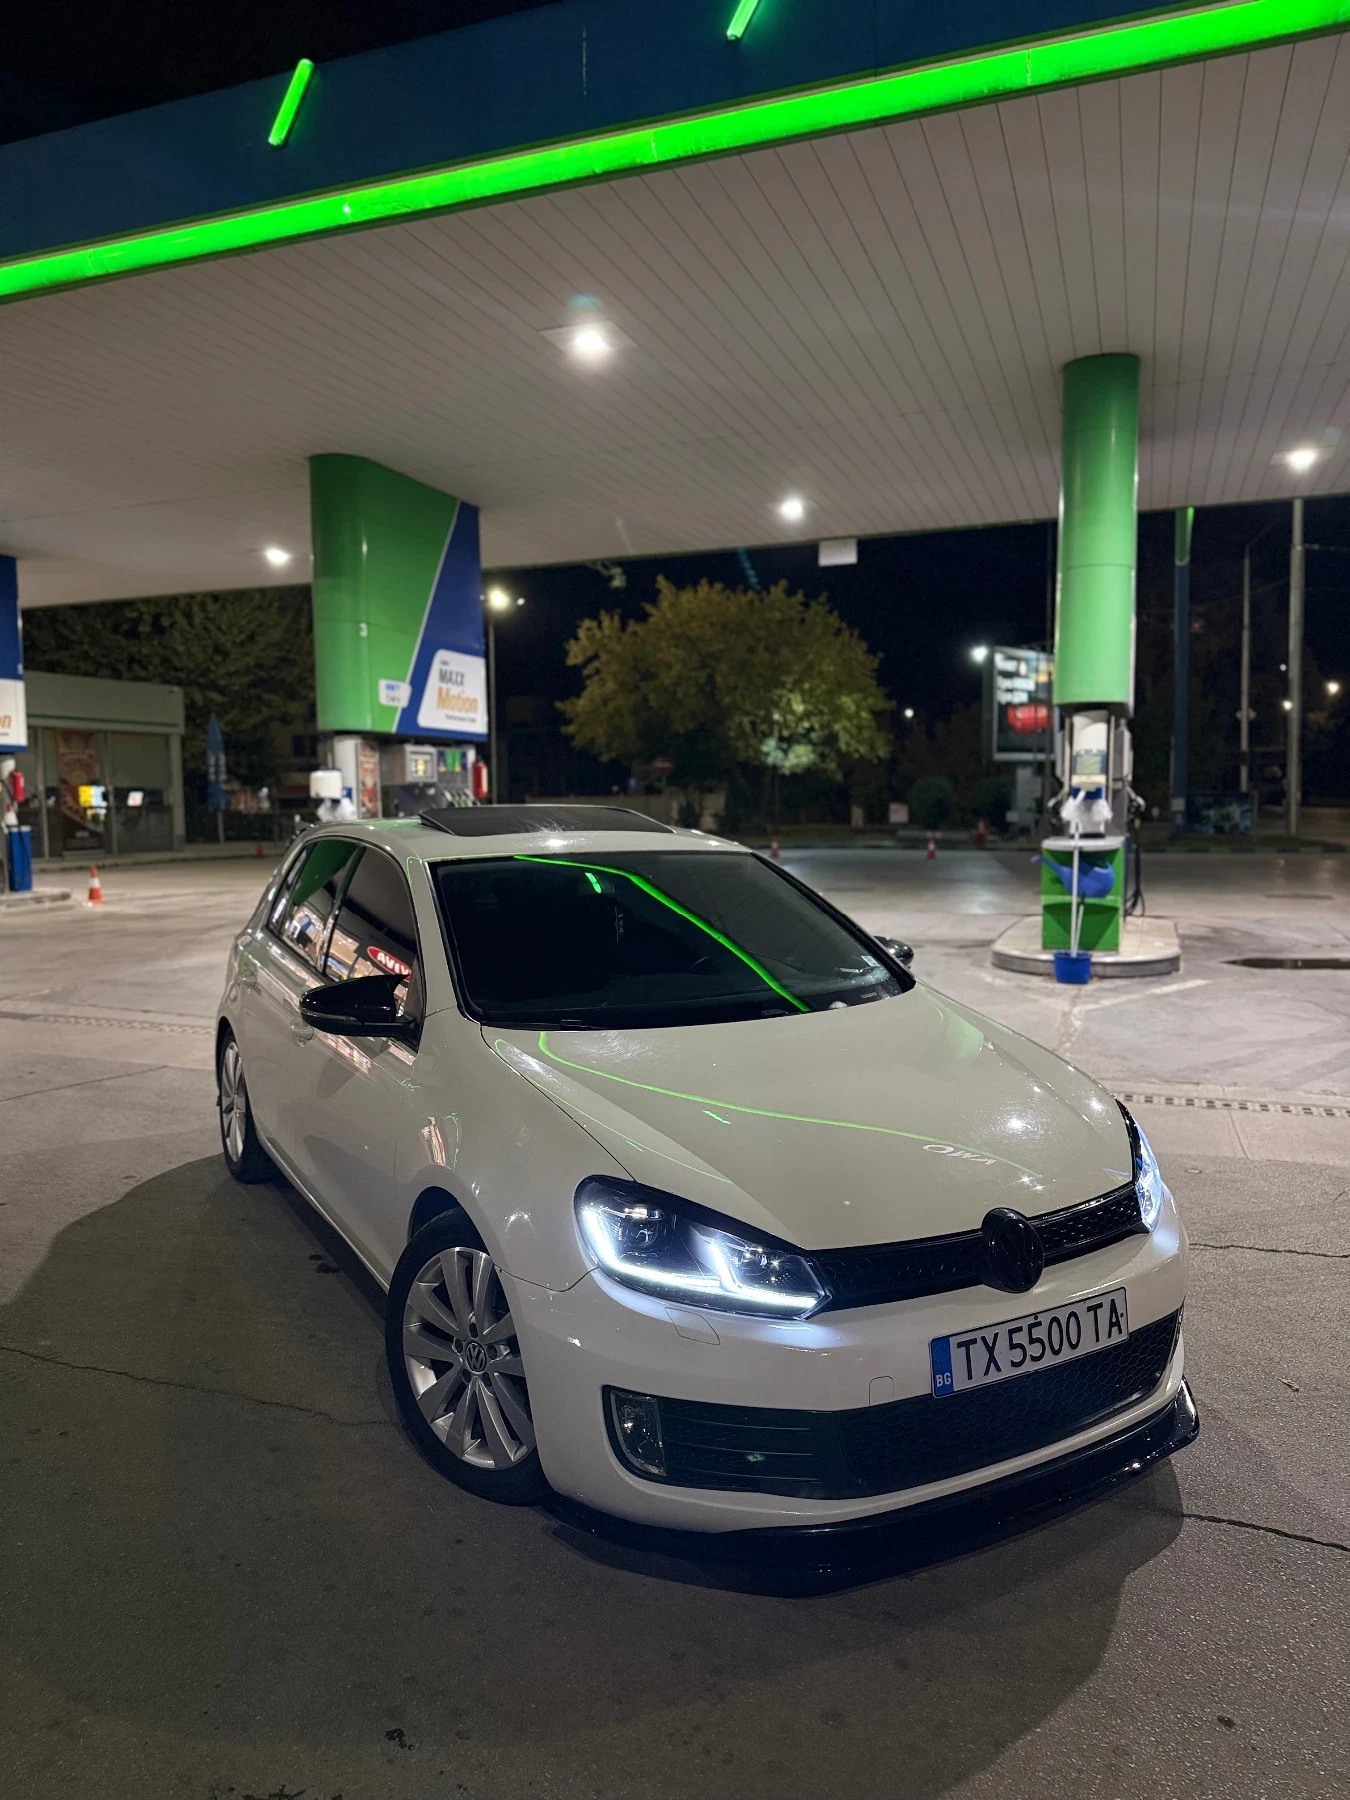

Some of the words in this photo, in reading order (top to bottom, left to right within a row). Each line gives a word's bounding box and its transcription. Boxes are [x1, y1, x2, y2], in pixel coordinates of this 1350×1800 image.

[439, 668, 465, 686] MAXX
[437, 686, 479, 713] Motion
[956, 1332, 1002, 1381] TX
[1007, 1310, 1082, 1368] 5500
[1086, 1298, 1123, 1343] TA
[935, 1372, 952, 1388] BG
